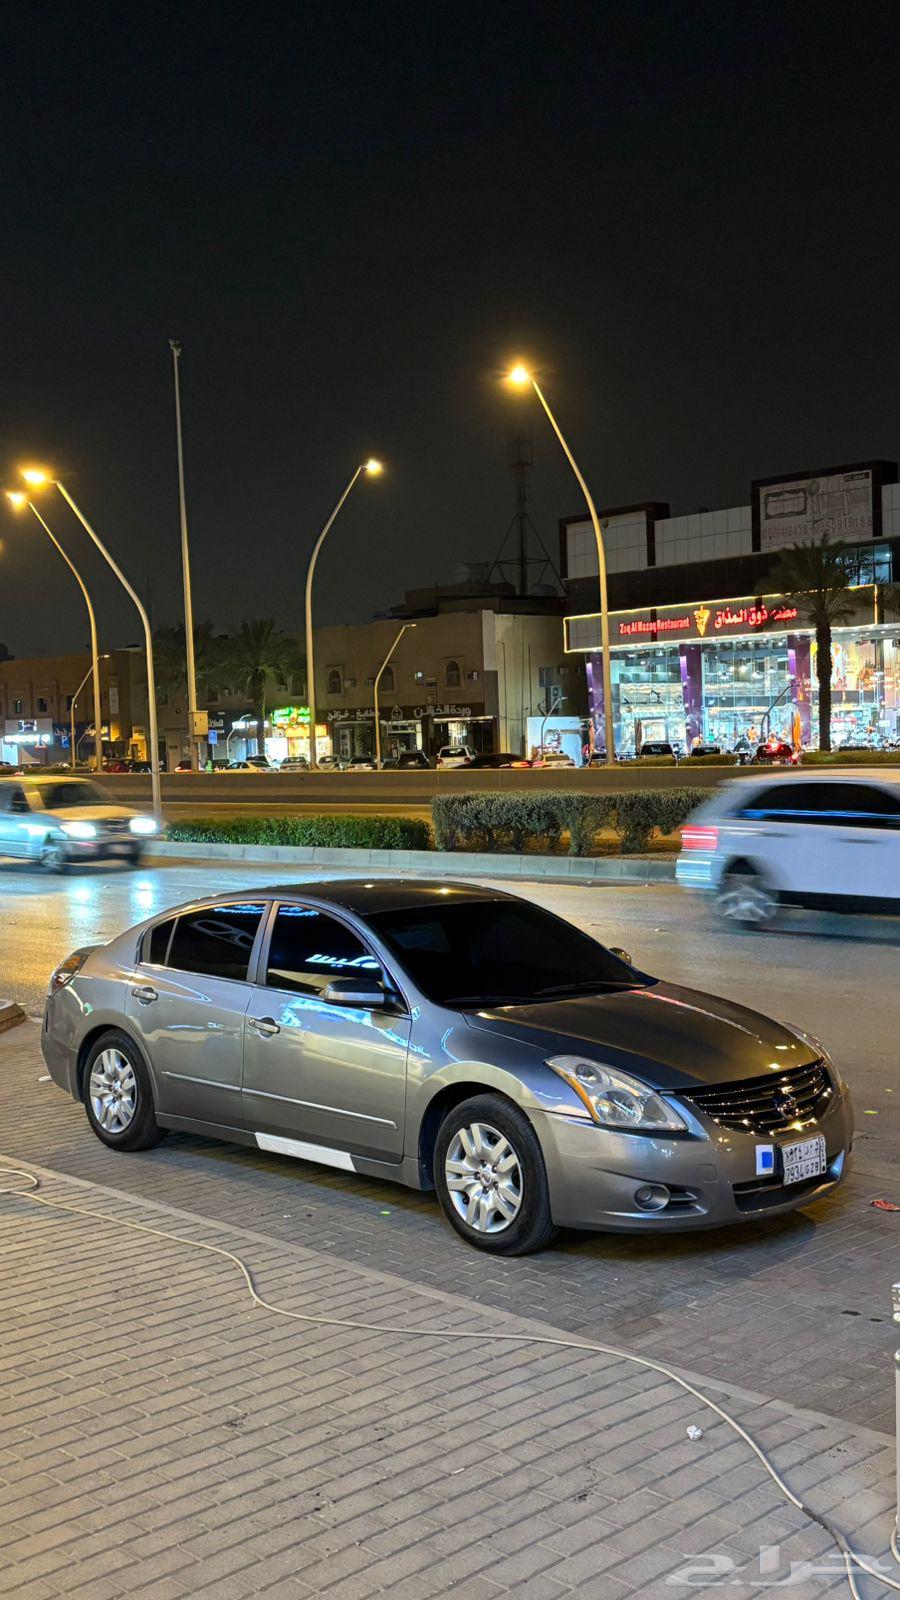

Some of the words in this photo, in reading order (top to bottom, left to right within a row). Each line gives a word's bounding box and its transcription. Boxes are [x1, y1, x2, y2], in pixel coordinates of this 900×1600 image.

[714, 607, 747, 629] المذاق
[748, 605, 768, 625] ذوق
[631, 621, 638, 633] Al
[638, 620, 656, 633] Mazaq
[657, 617, 690, 632] Restaurant
[356, 708, 380, 720] طابخ
[449, 704, 472, 717] وردة
[785, 1163, 804, 1184] 7934
